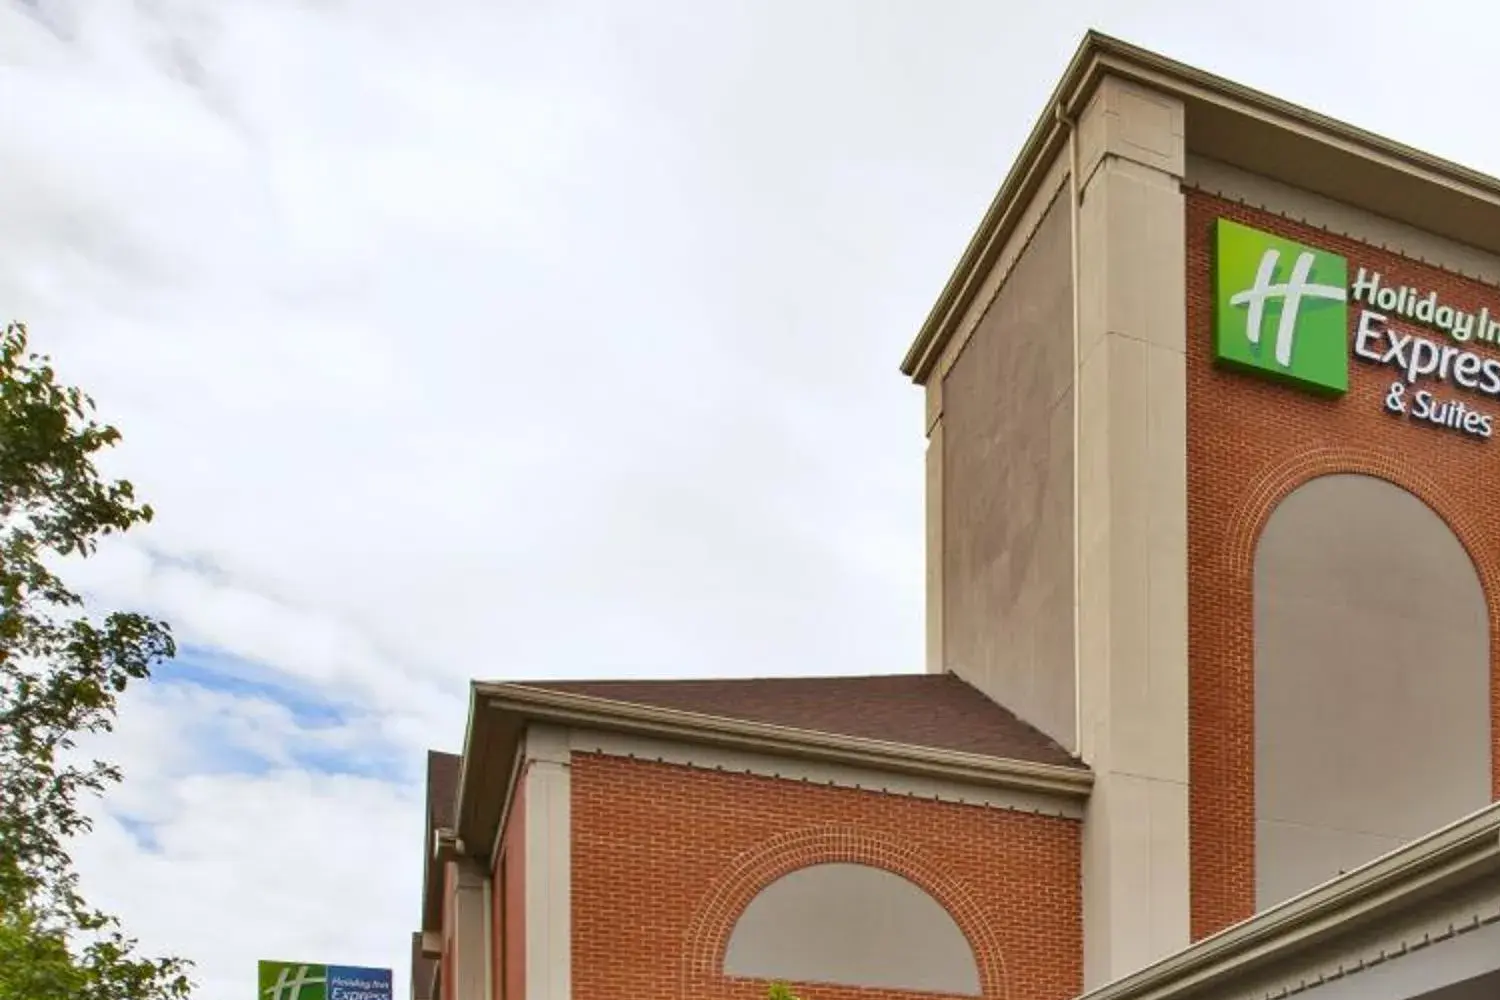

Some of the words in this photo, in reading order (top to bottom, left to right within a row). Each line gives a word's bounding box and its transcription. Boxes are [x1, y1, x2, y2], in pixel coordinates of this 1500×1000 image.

[1352, 267, 1474, 341] Holiday
[1386, 382, 1406, 414] &
[1412, 390, 1493, 438] Suites
